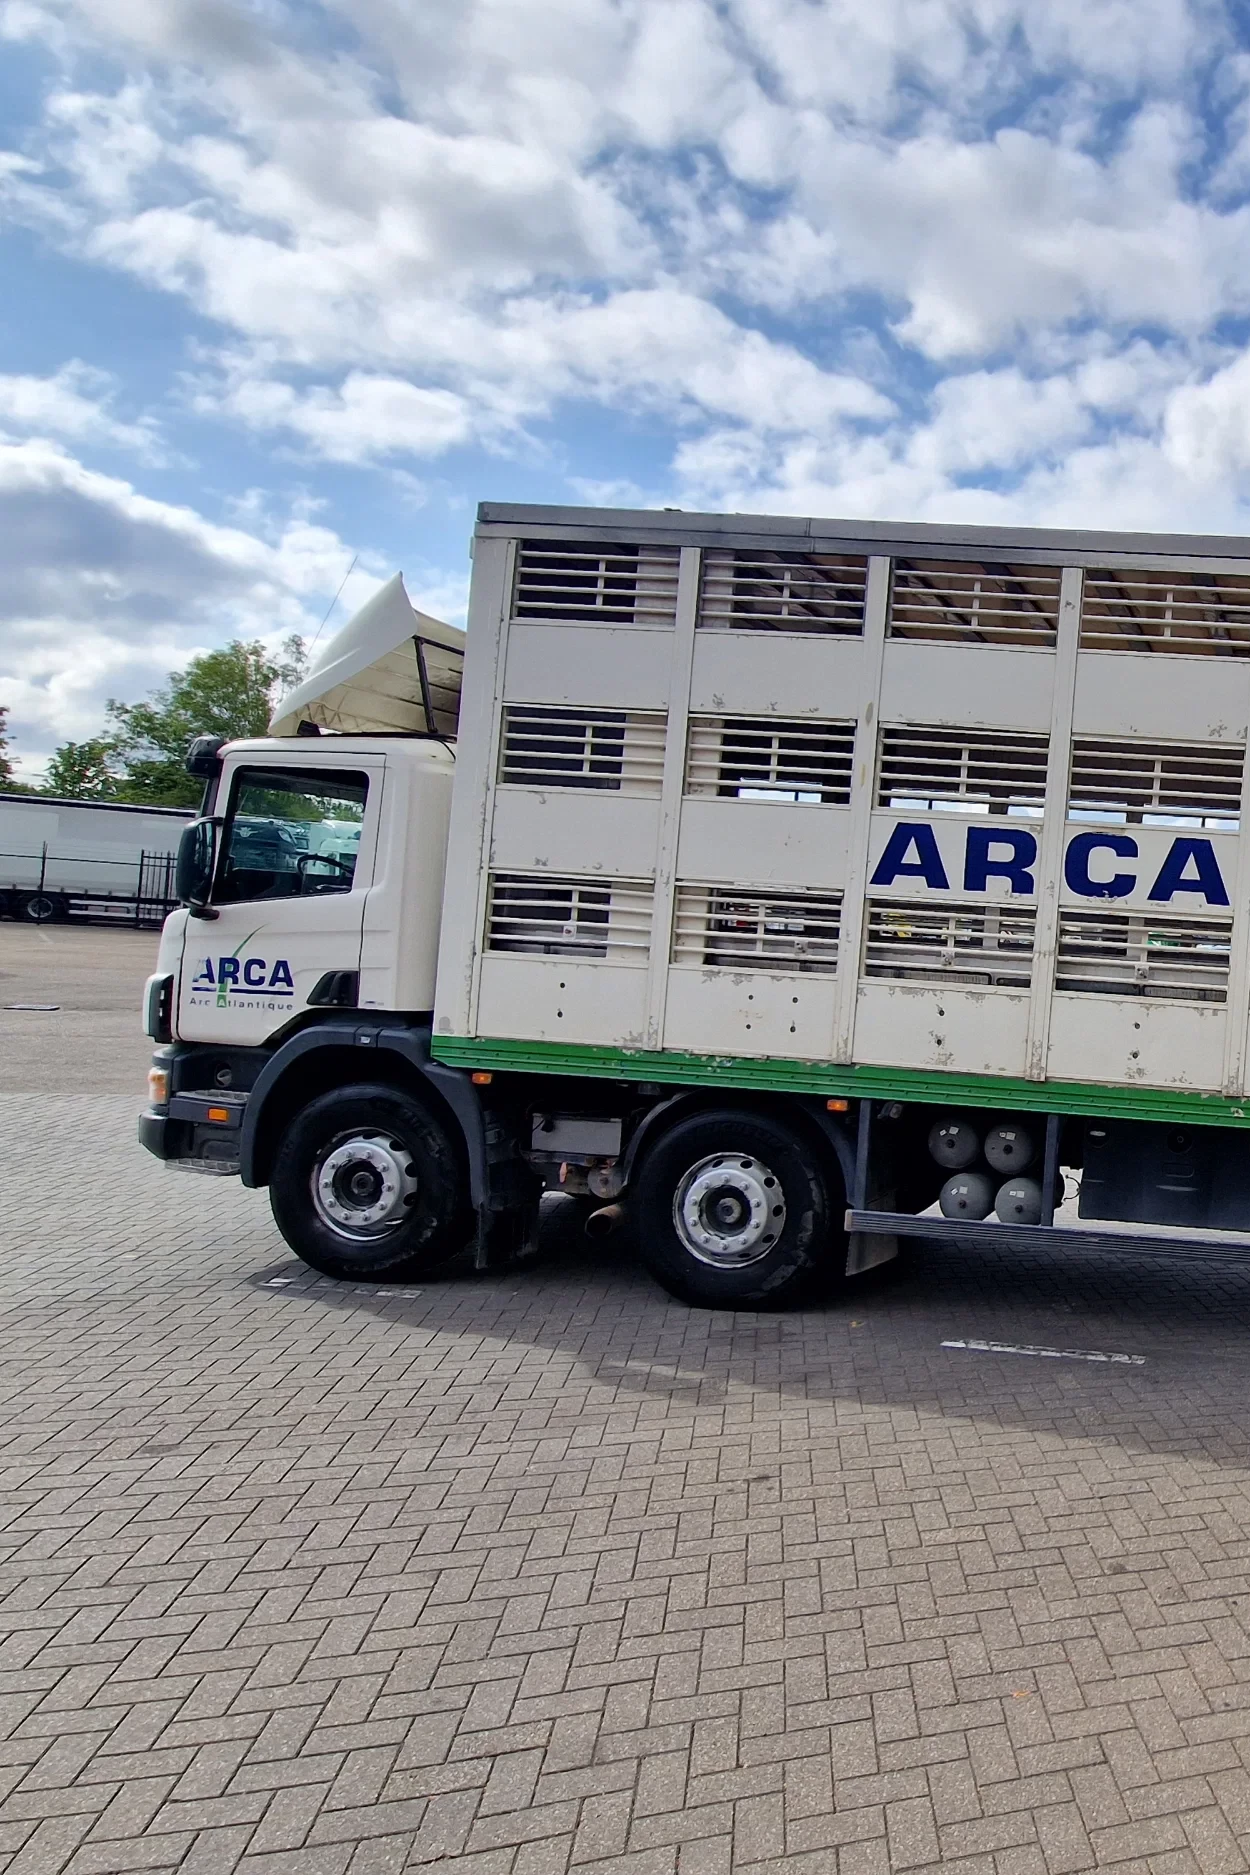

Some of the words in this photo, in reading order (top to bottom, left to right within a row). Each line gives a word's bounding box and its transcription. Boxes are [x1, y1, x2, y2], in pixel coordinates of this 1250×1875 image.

[869, 822, 1230, 906] ARCA
[192, 957, 294, 987] ARCA
[189, 997, 211, 1006] Arc
[217, 996, 293, 1010] Atlantique
